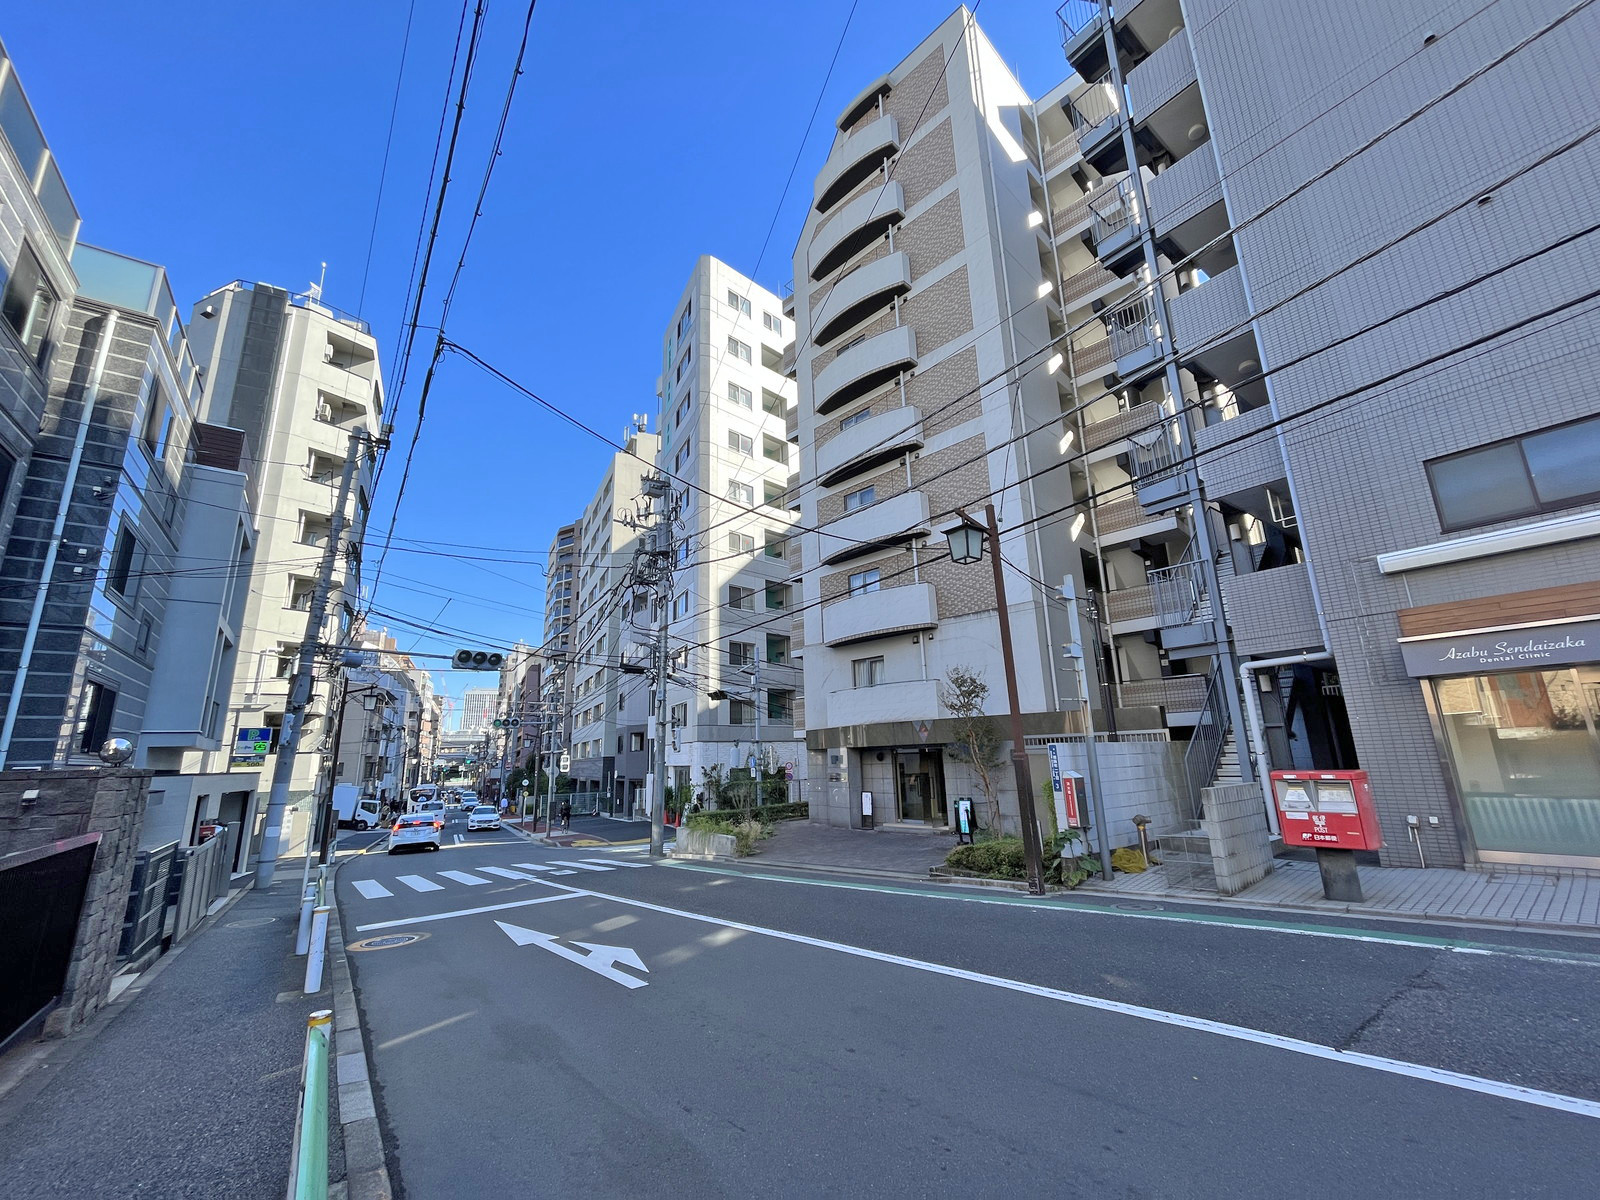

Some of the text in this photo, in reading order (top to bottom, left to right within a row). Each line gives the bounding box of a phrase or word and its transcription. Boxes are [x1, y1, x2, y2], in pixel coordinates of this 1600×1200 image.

[1439, 636, 1586, 661] Azabu Sendaizaka
[1480, 652, 1551, 663] Dental Clinic
